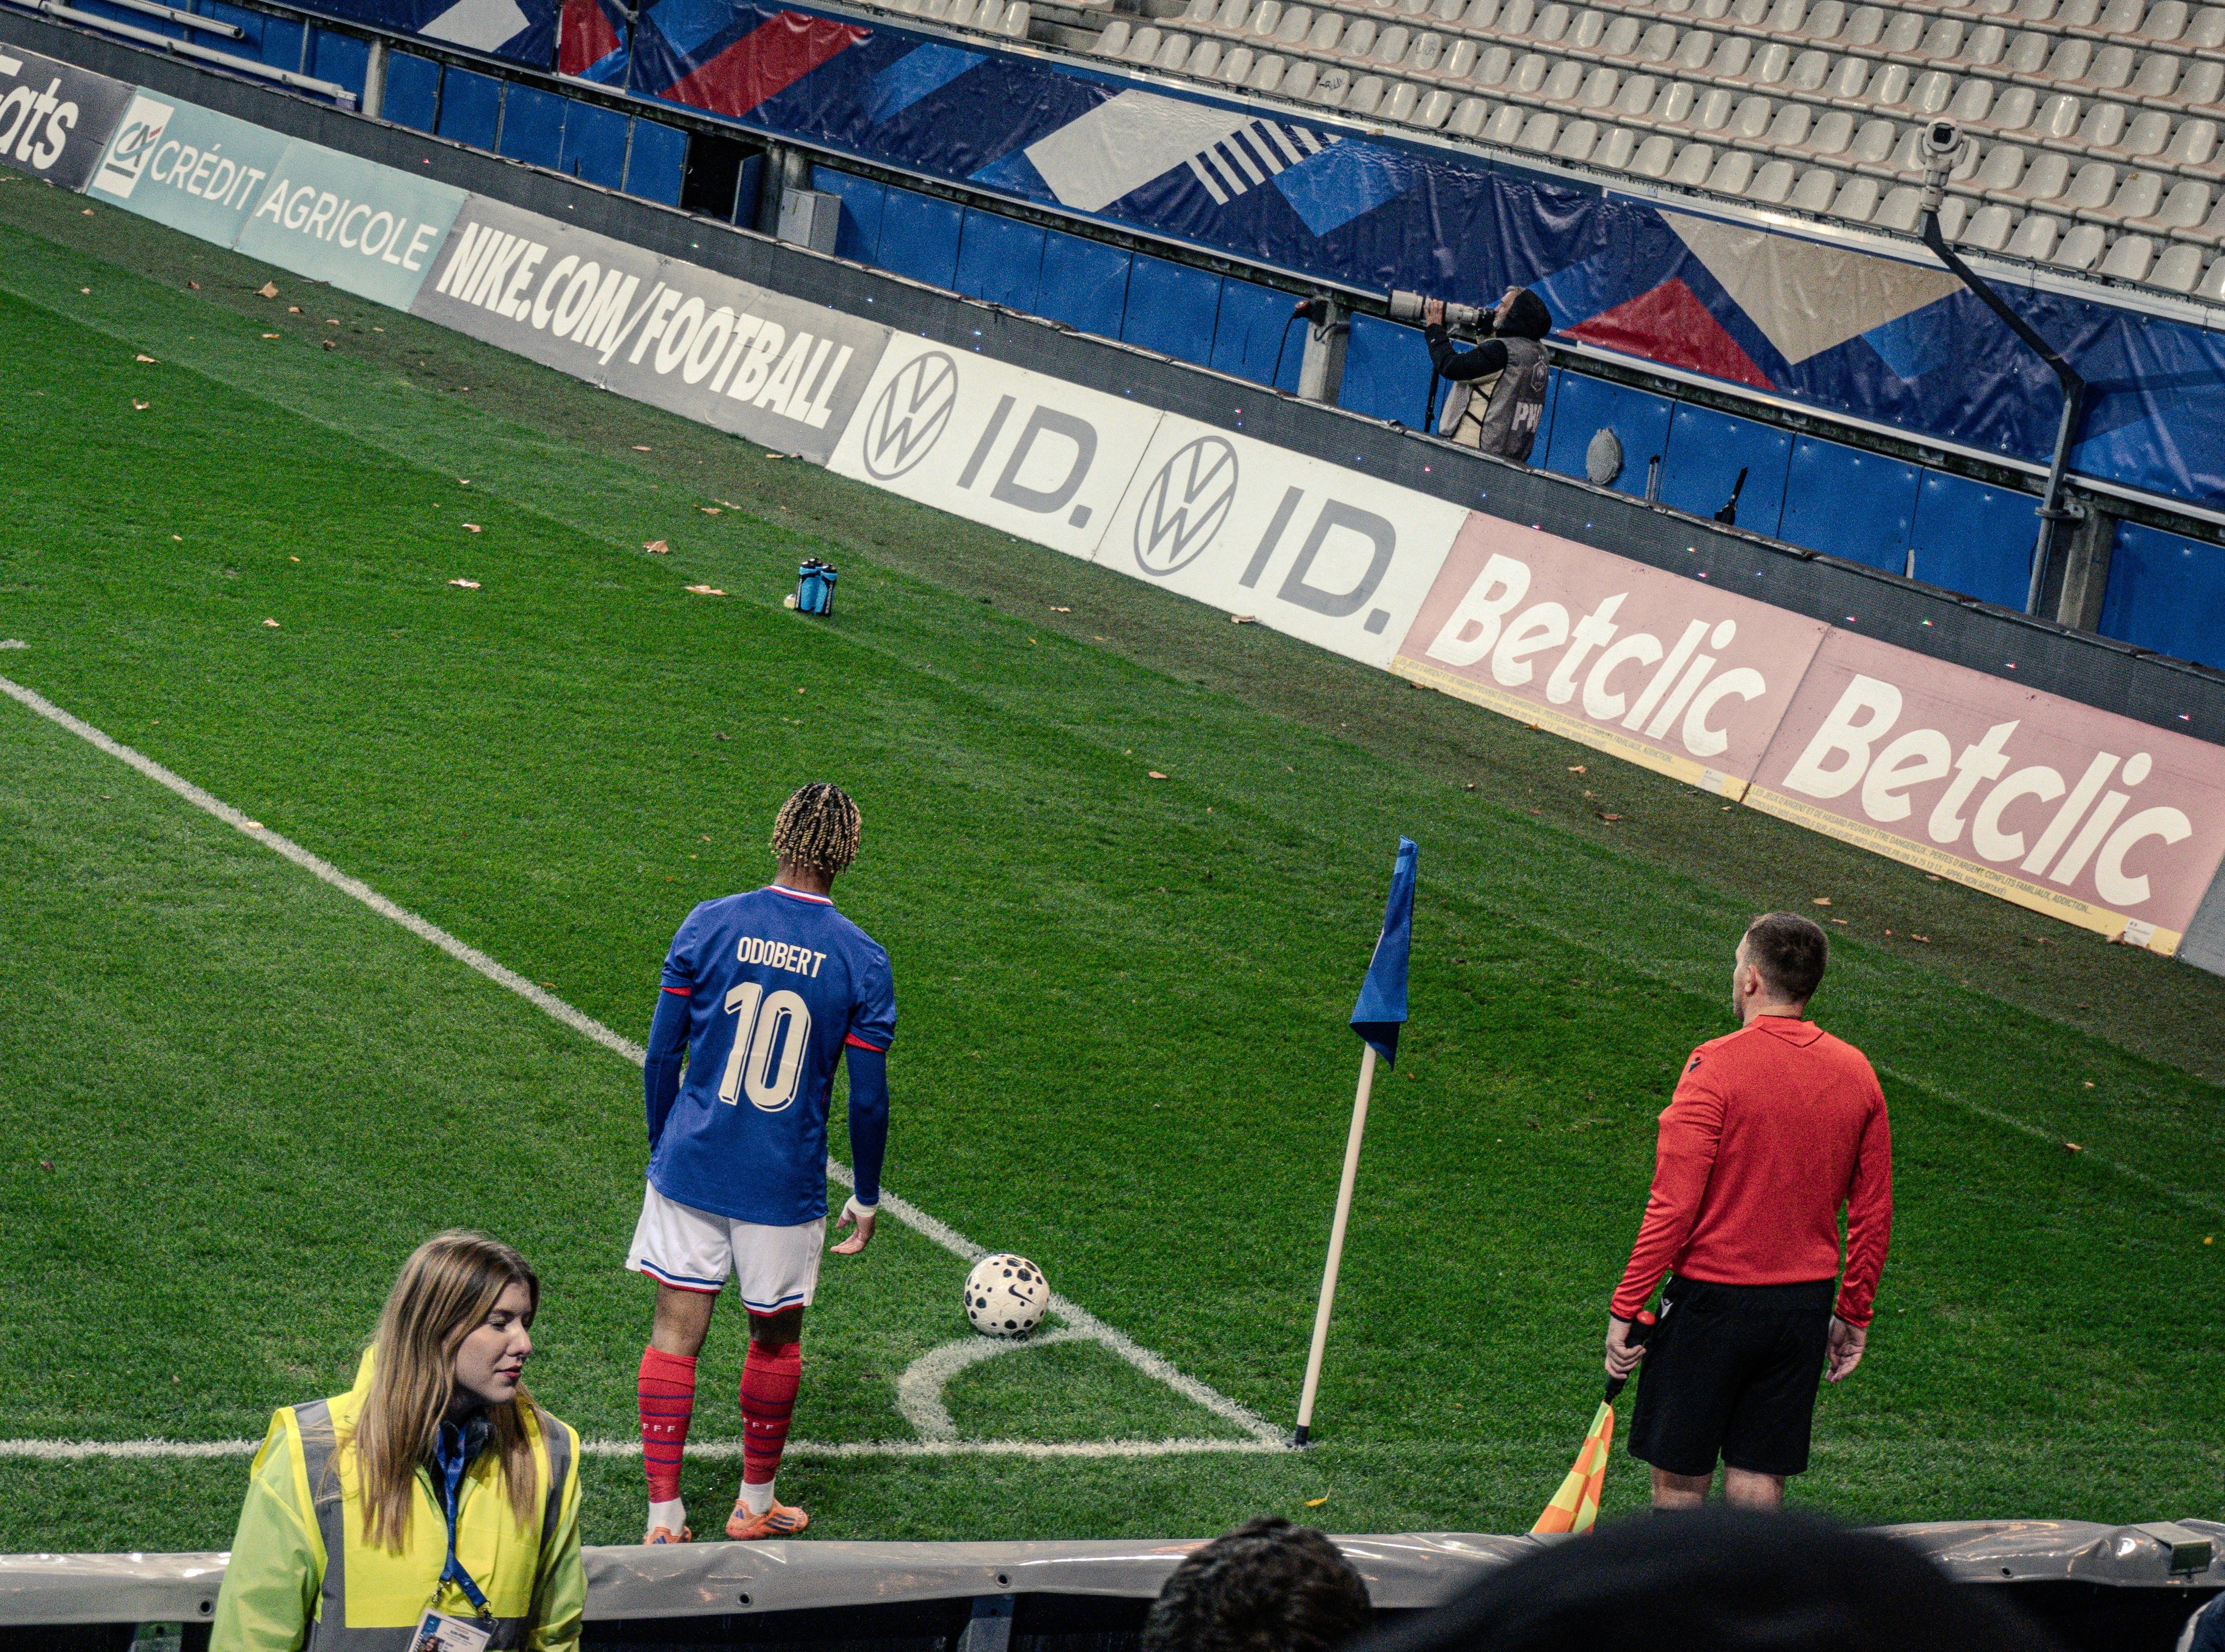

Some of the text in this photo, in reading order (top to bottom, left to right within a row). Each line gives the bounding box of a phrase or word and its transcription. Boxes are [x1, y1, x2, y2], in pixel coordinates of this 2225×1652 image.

[150, 140, 438, 271] CRÉDIT AGRICOLE
[436, 221, 854, 428] NIKE.COM/FOOTBALL
[956, 395, 1098, 529] ID.
[1239, 486, 1396, 635] ID.
[1424, 553, 1766, 757] Betclic
[1752, 787, 1763, 796] LES
[1814, 810, 1823, 818] DE
[1929, 850, 1953, 863] PERTES
[1782, 674, 2192, 907] Betclic
[737, 936, 827, 978] ODOBERT
[718, 981, 811, 1112] 10
